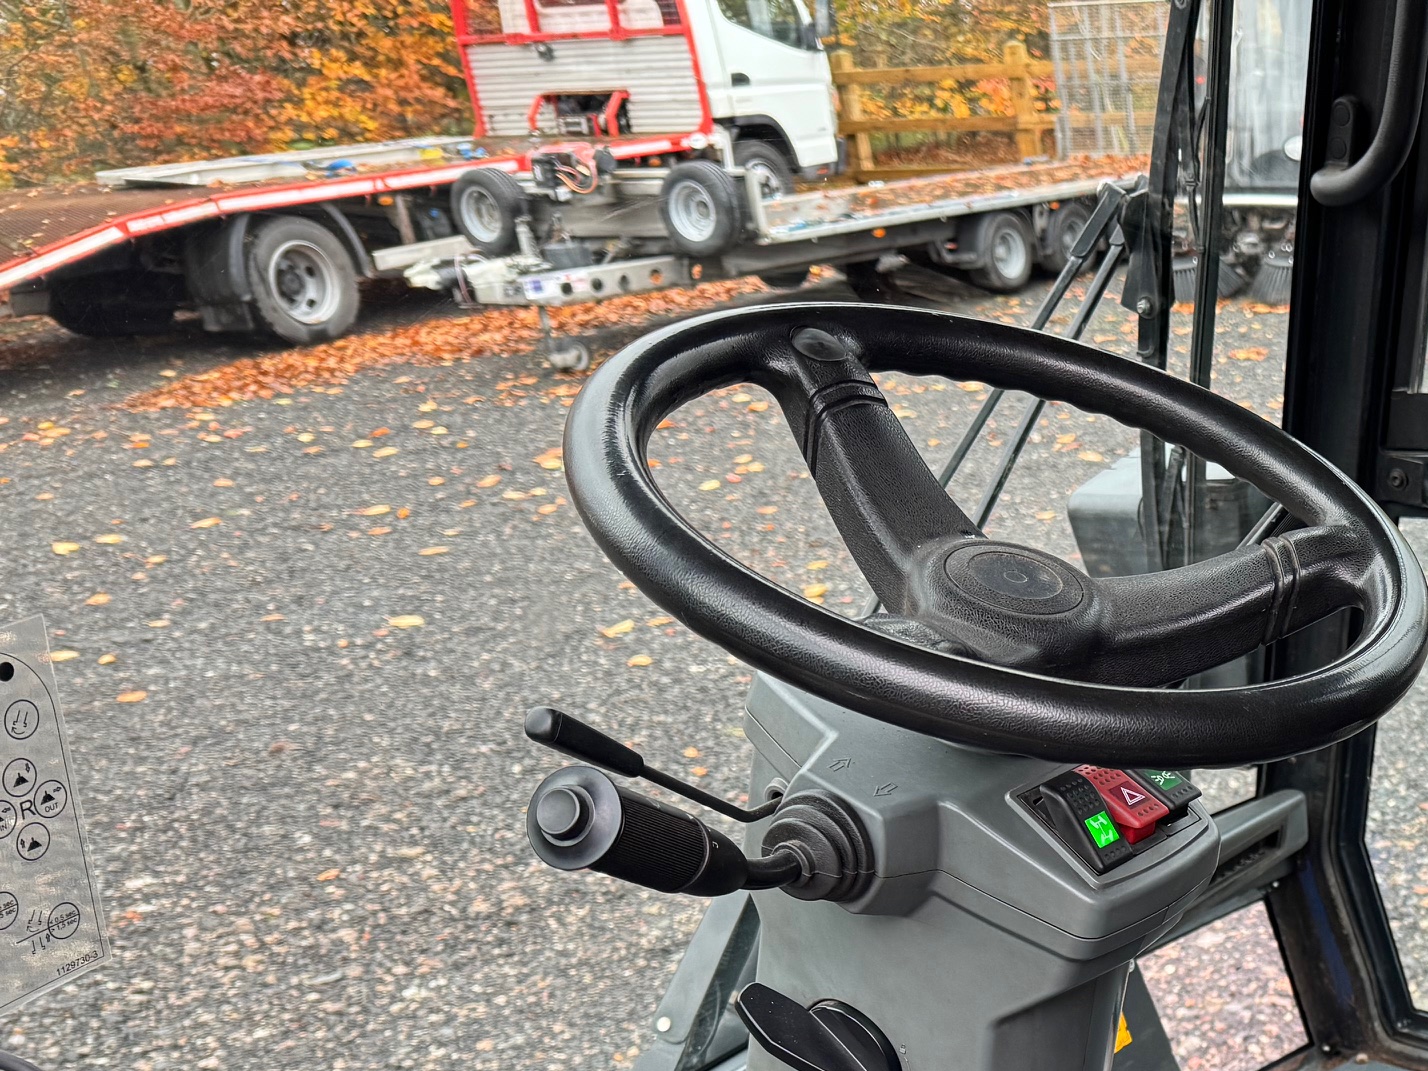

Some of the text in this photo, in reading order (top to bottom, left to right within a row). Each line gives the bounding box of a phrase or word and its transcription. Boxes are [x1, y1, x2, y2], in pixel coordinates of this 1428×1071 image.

[20, 799, 37, 820] R
[44, 802, 59, 813] OUT
[57, 950, 99, 976] 1129730-3
